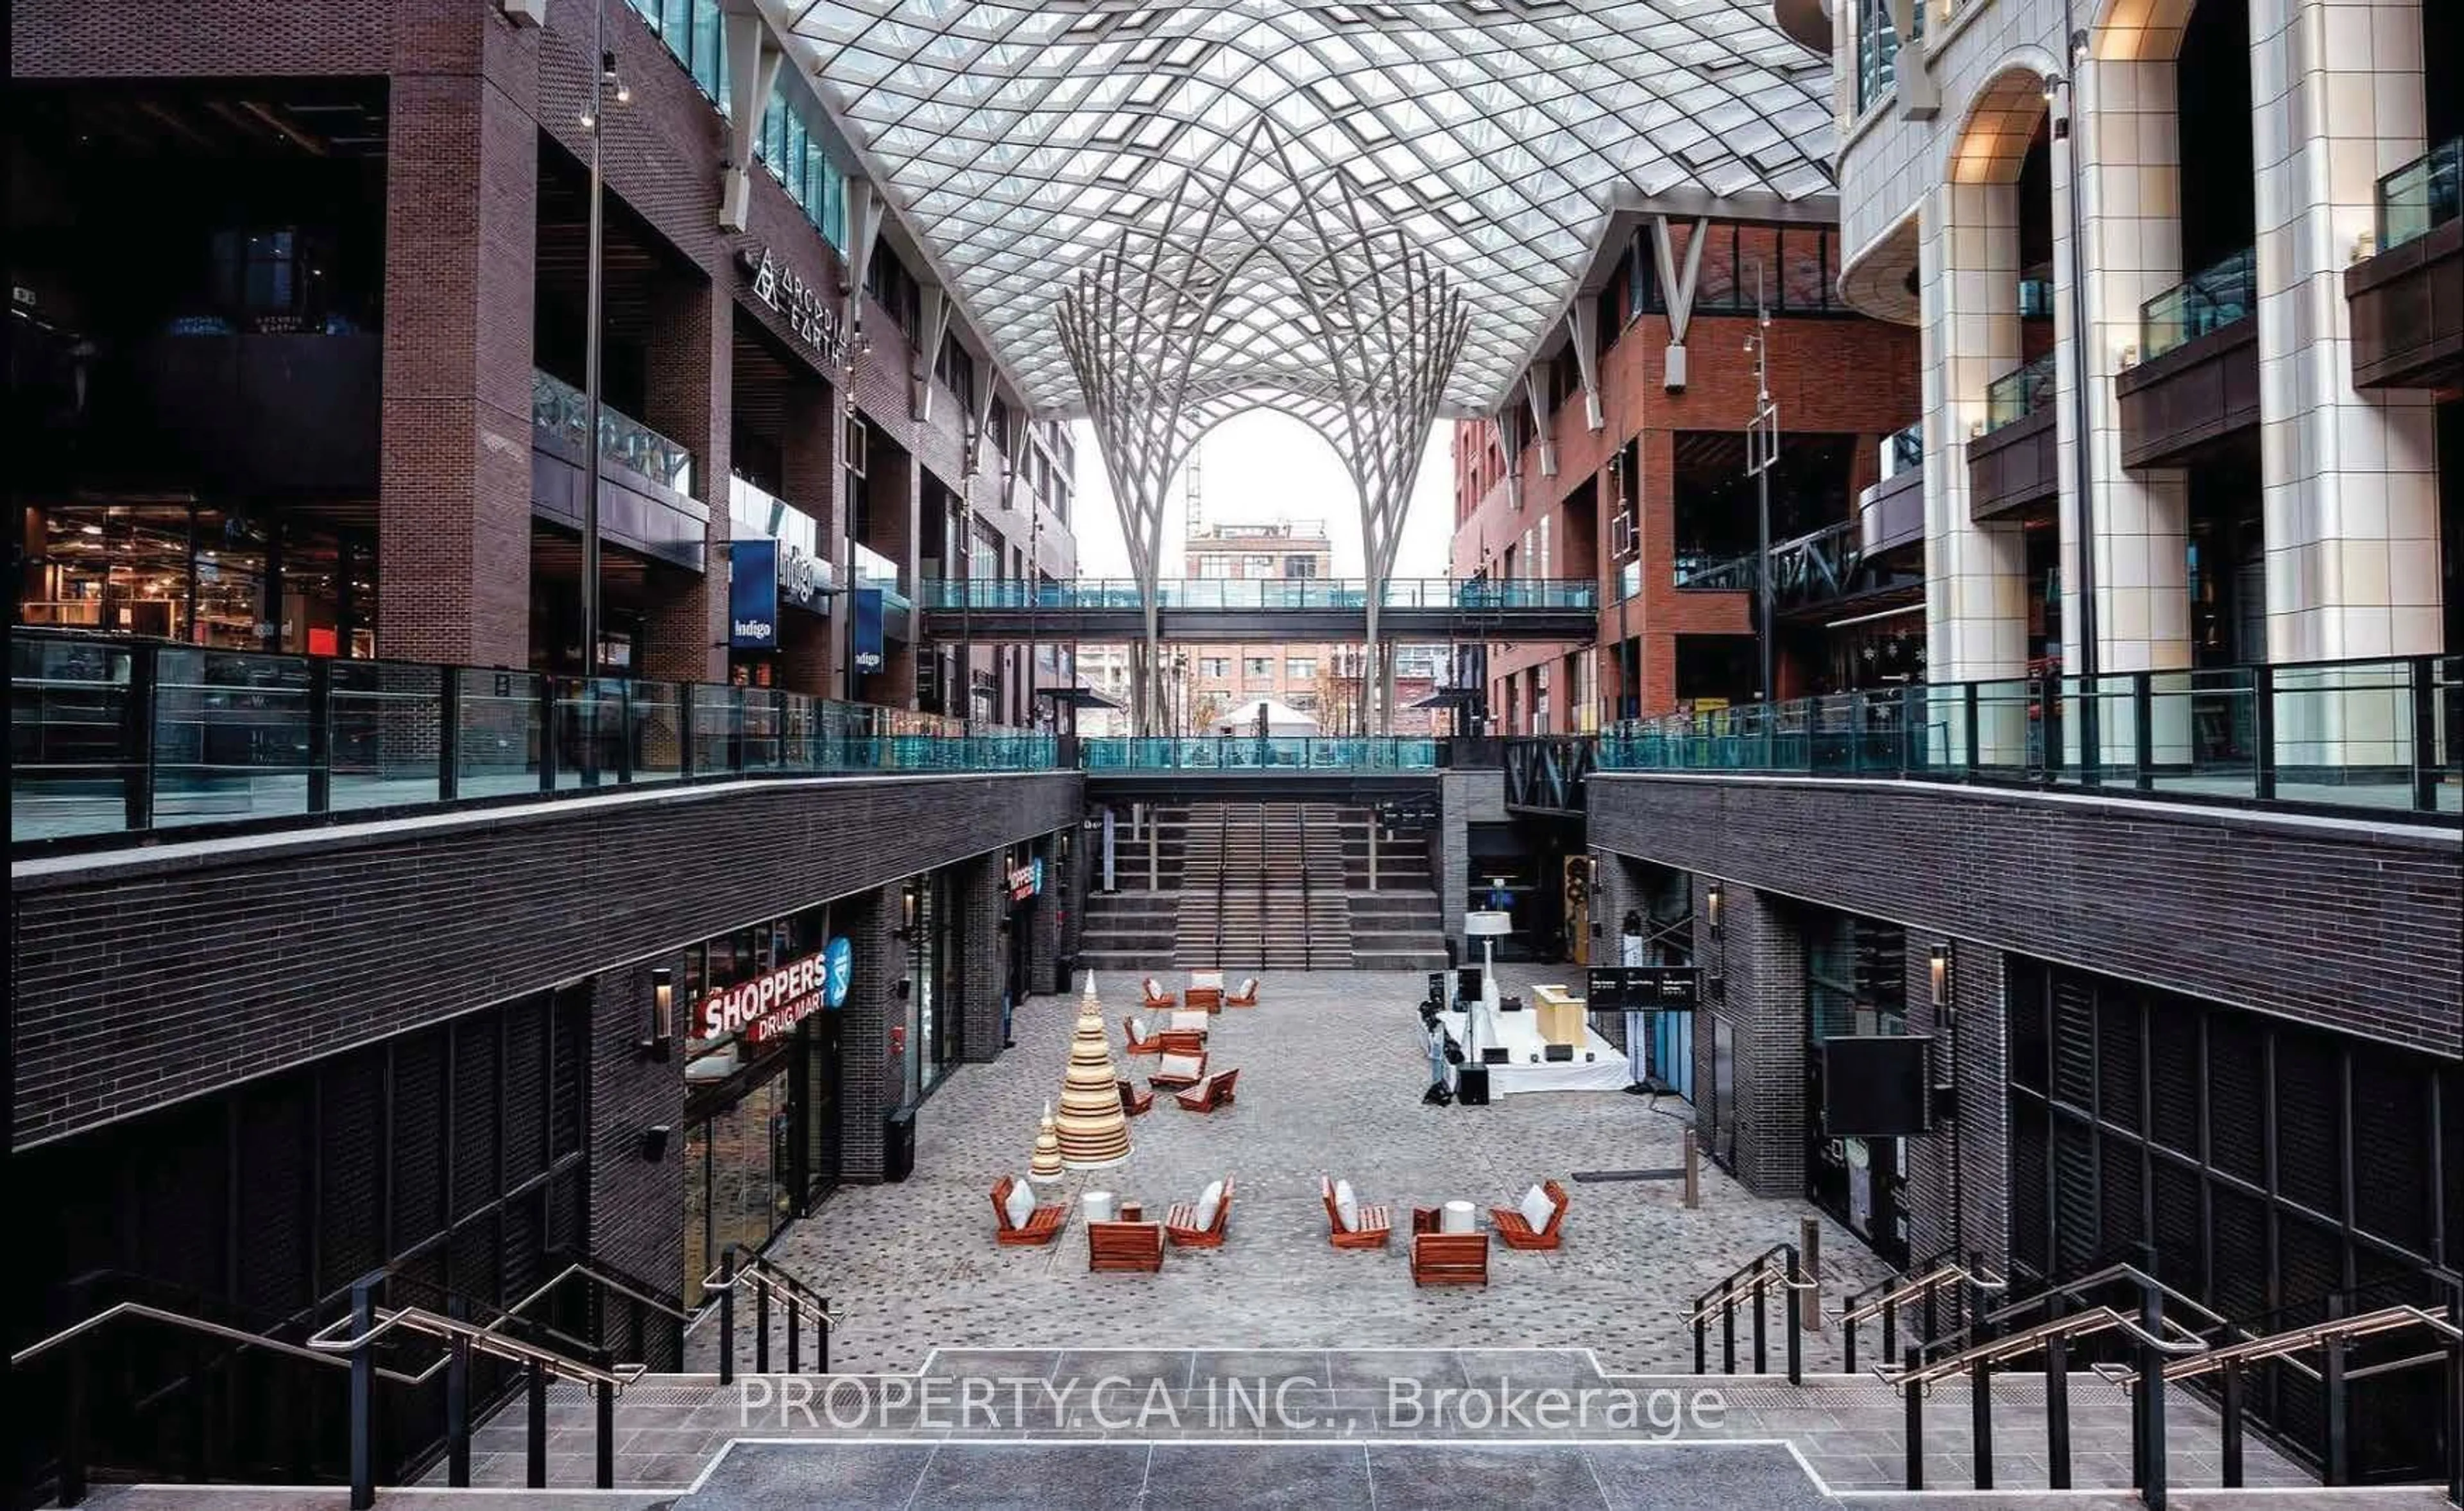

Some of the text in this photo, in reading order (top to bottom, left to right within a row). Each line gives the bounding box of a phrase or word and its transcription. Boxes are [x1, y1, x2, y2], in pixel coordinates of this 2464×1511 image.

[782, 267, 847, 348] ARCADIA
[791, 304, 840, 369] EARTH
[735, 619, 771, 639] Indigo
[855, 652, 880, 666] ndigo
[705, 954, 826, 1040] SHOPPERS
[759, 989, 826, 1041] DRUG MART
